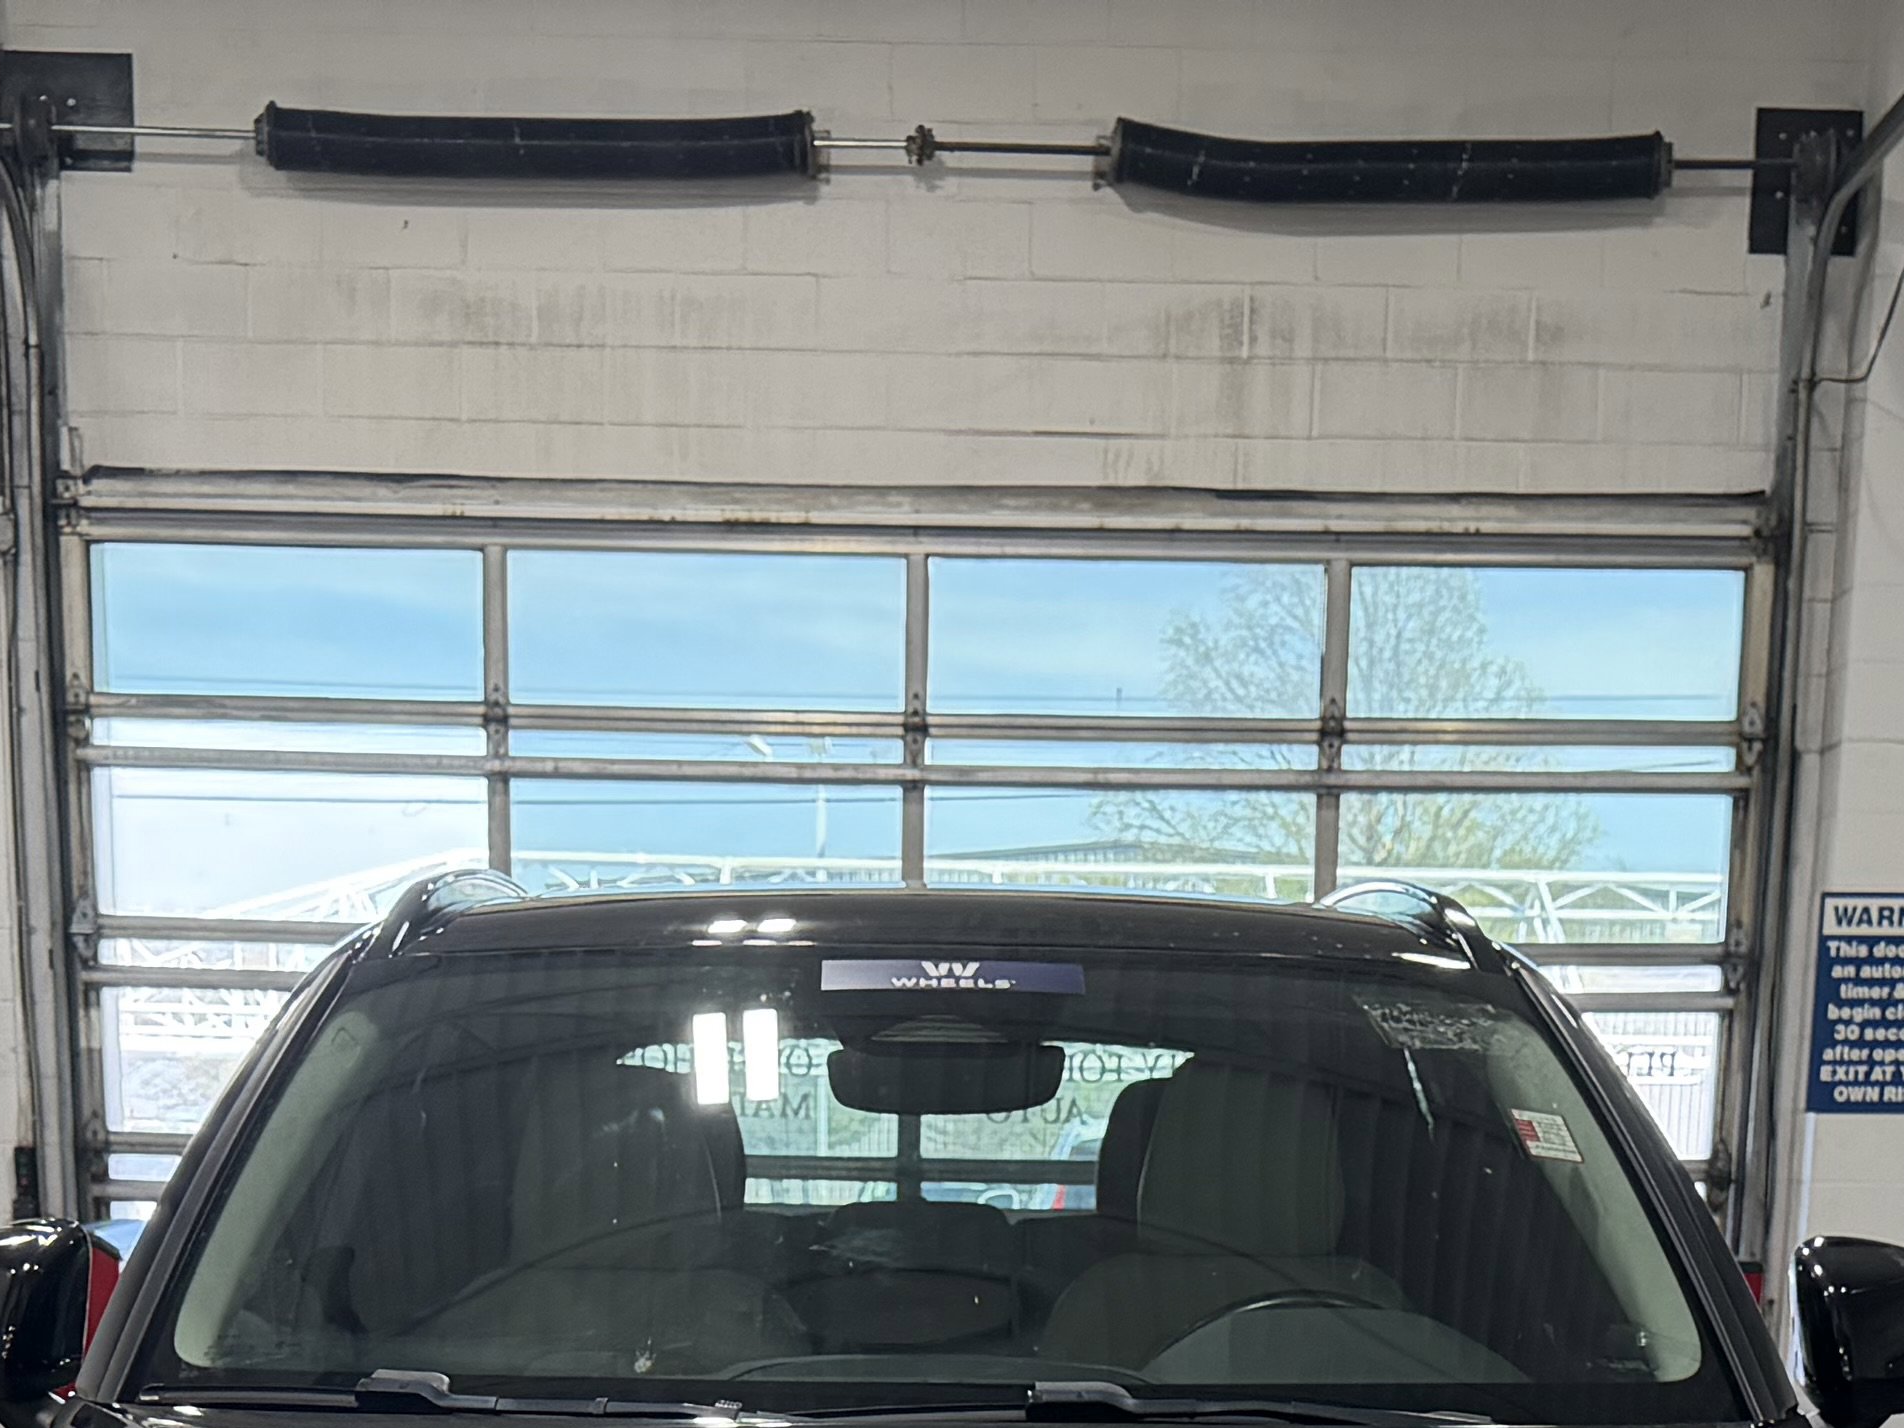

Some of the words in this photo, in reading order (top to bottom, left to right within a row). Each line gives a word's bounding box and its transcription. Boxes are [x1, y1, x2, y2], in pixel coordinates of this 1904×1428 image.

[1826, 940, 1869, 958] This
[1831, 964, 1856, 979] an
[891, 976, 1011, 989] WHEELS
[1840, 983, 1890, 1000] timer
[1827, 1003, 1882, 1022] begin
[1833, 1024, 1860, 1041] 30
[1822, 1045, 1869, 1062] after
[1820, 1065, 1868, 1082] EXIT
[1870, 1065, 1896, 1082] AT
[1833, 1085, 1880, 1103] OWN
